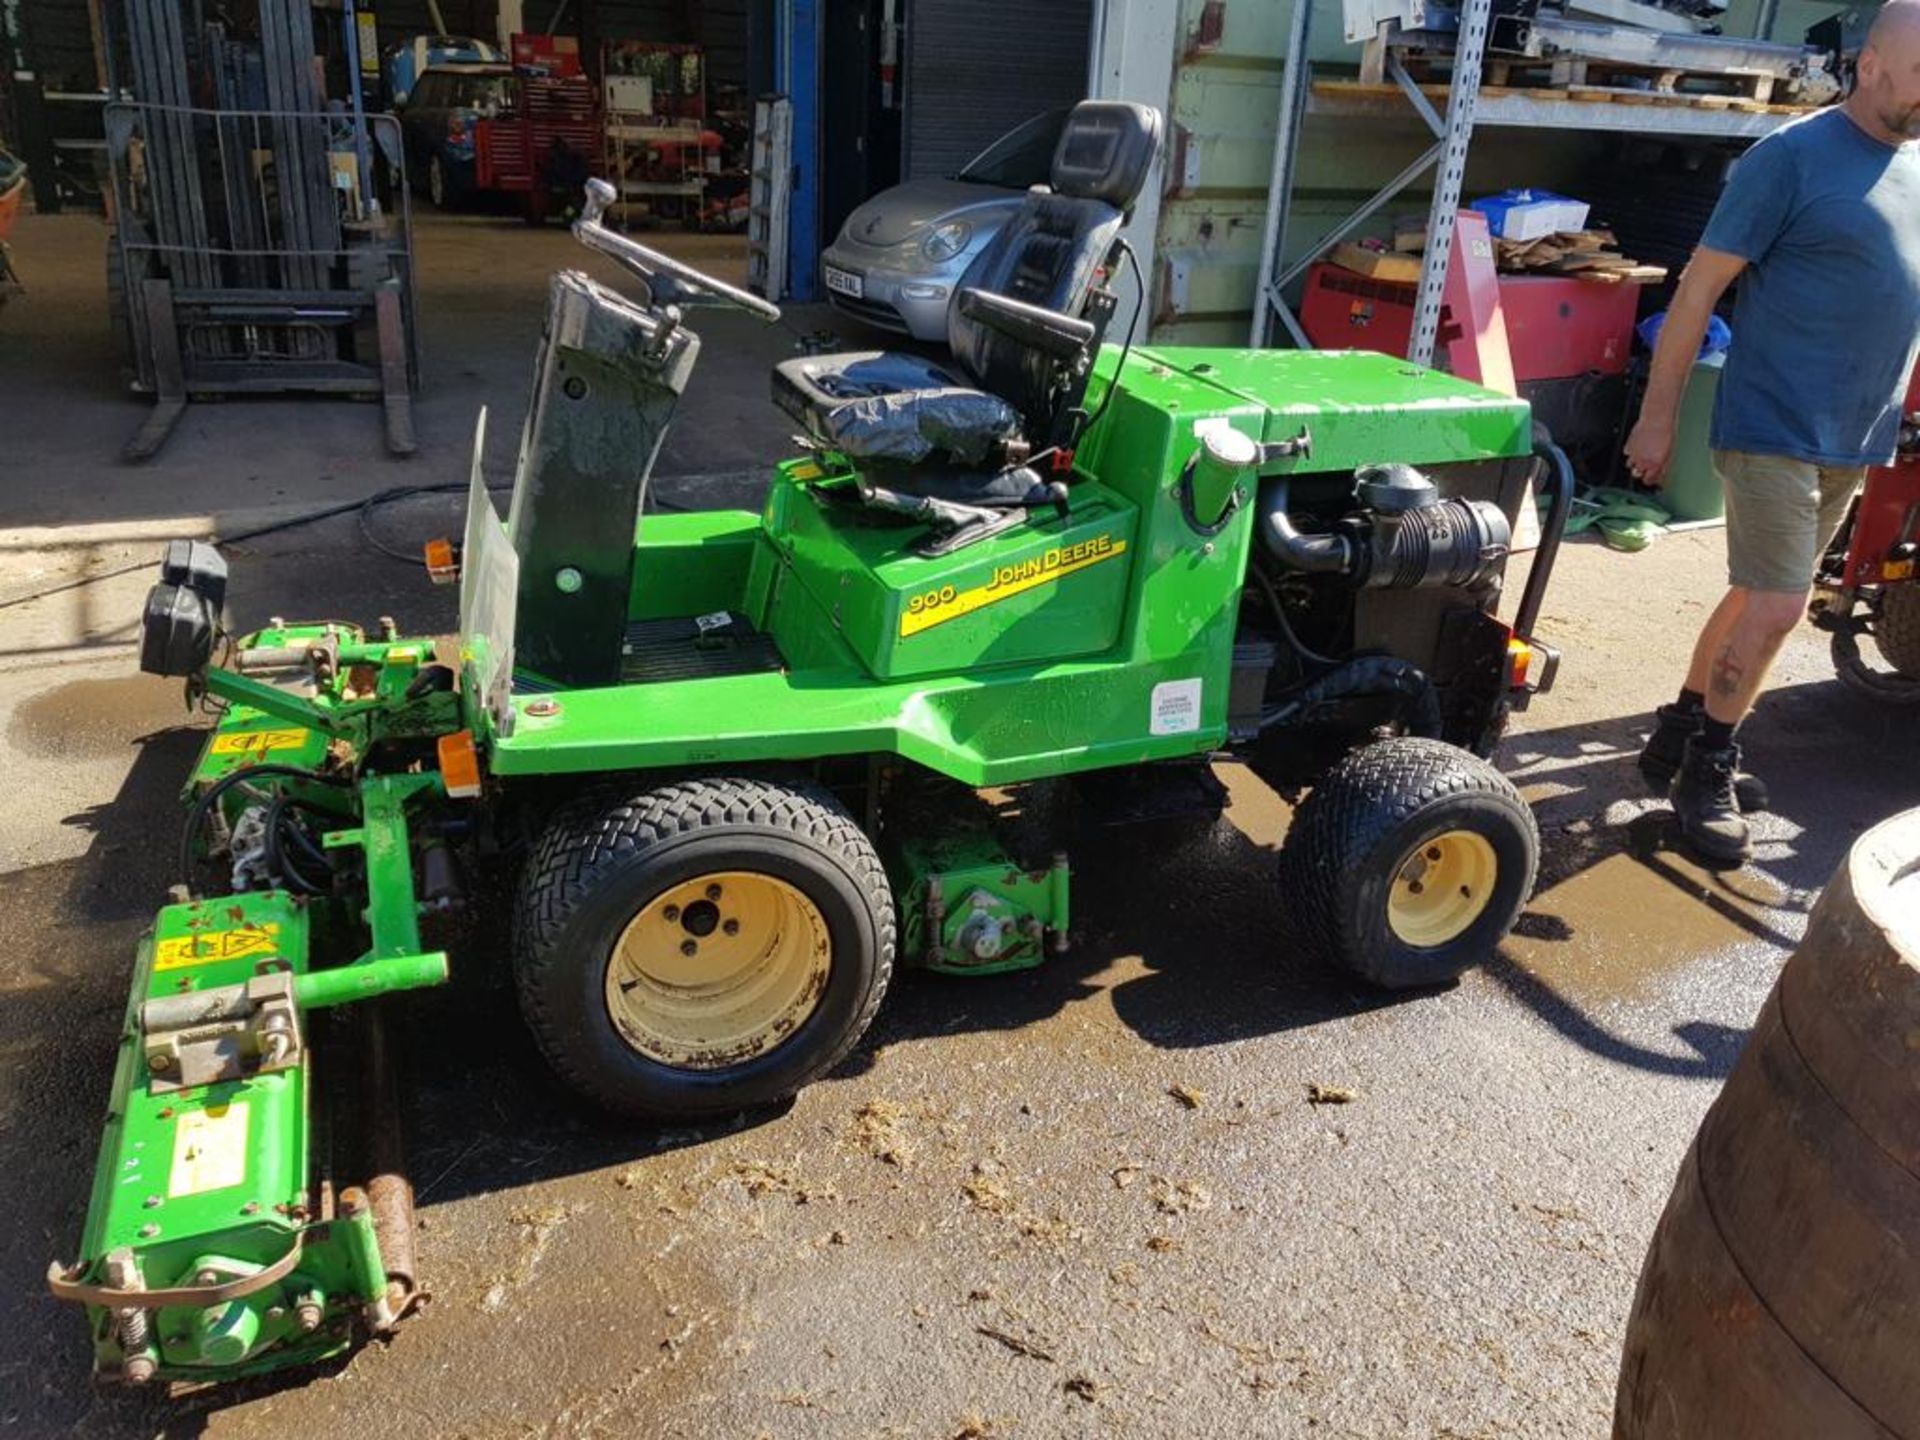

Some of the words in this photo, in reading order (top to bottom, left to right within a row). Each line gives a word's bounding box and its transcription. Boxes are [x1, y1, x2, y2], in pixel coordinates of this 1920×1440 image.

[909, 585, 957, 614] 900
[986, 557, 1042, 591] JOHN
[1044, 534, 1113, 569] DEERE
